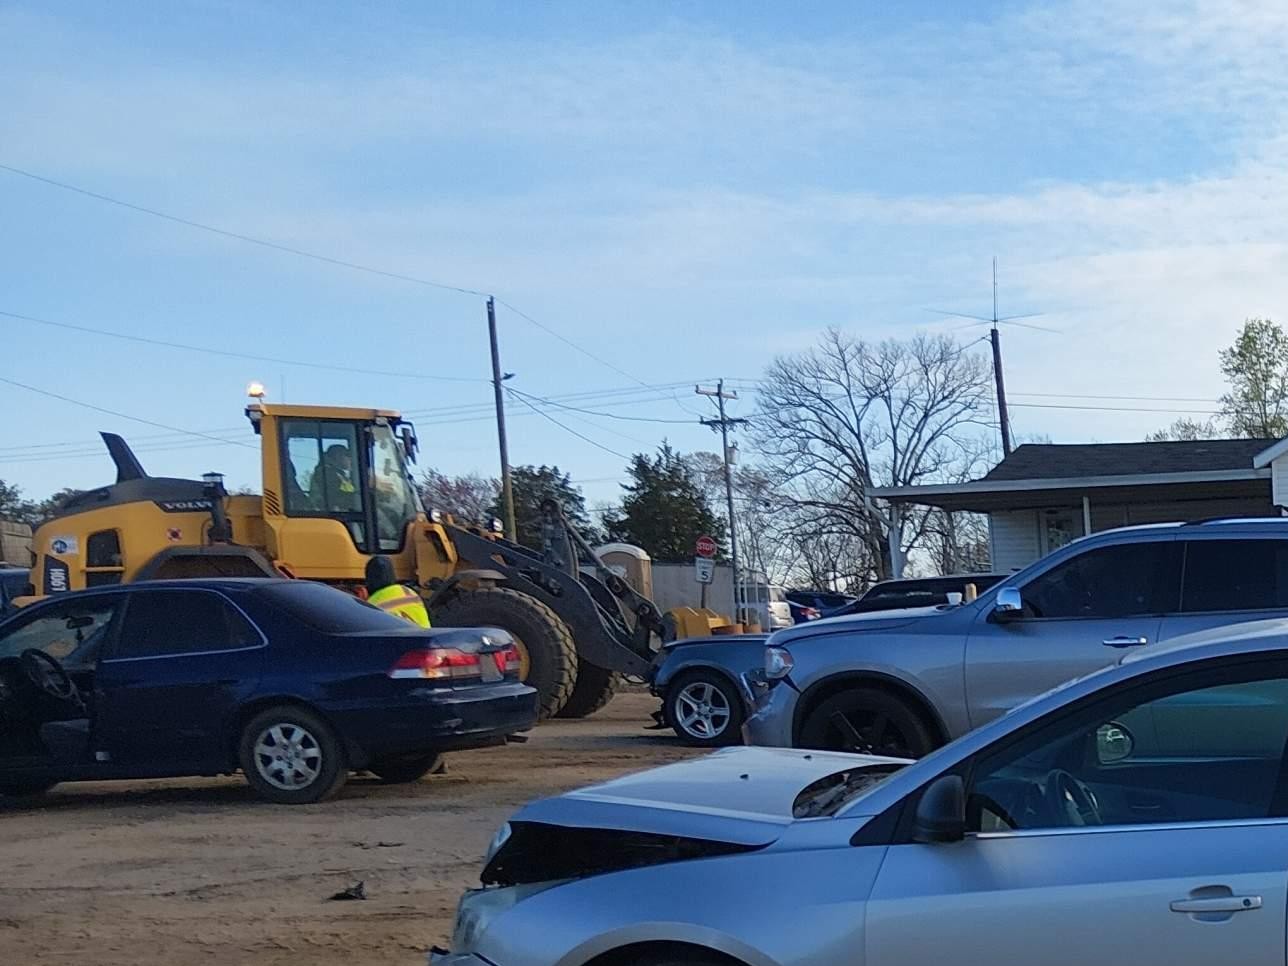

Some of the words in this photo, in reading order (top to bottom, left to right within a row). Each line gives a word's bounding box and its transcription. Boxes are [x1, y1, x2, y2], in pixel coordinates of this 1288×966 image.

[697, 542, 715, 551] STOP
[49, 568, 67, 592] L90H
[701, 570, 709, 581] 5
